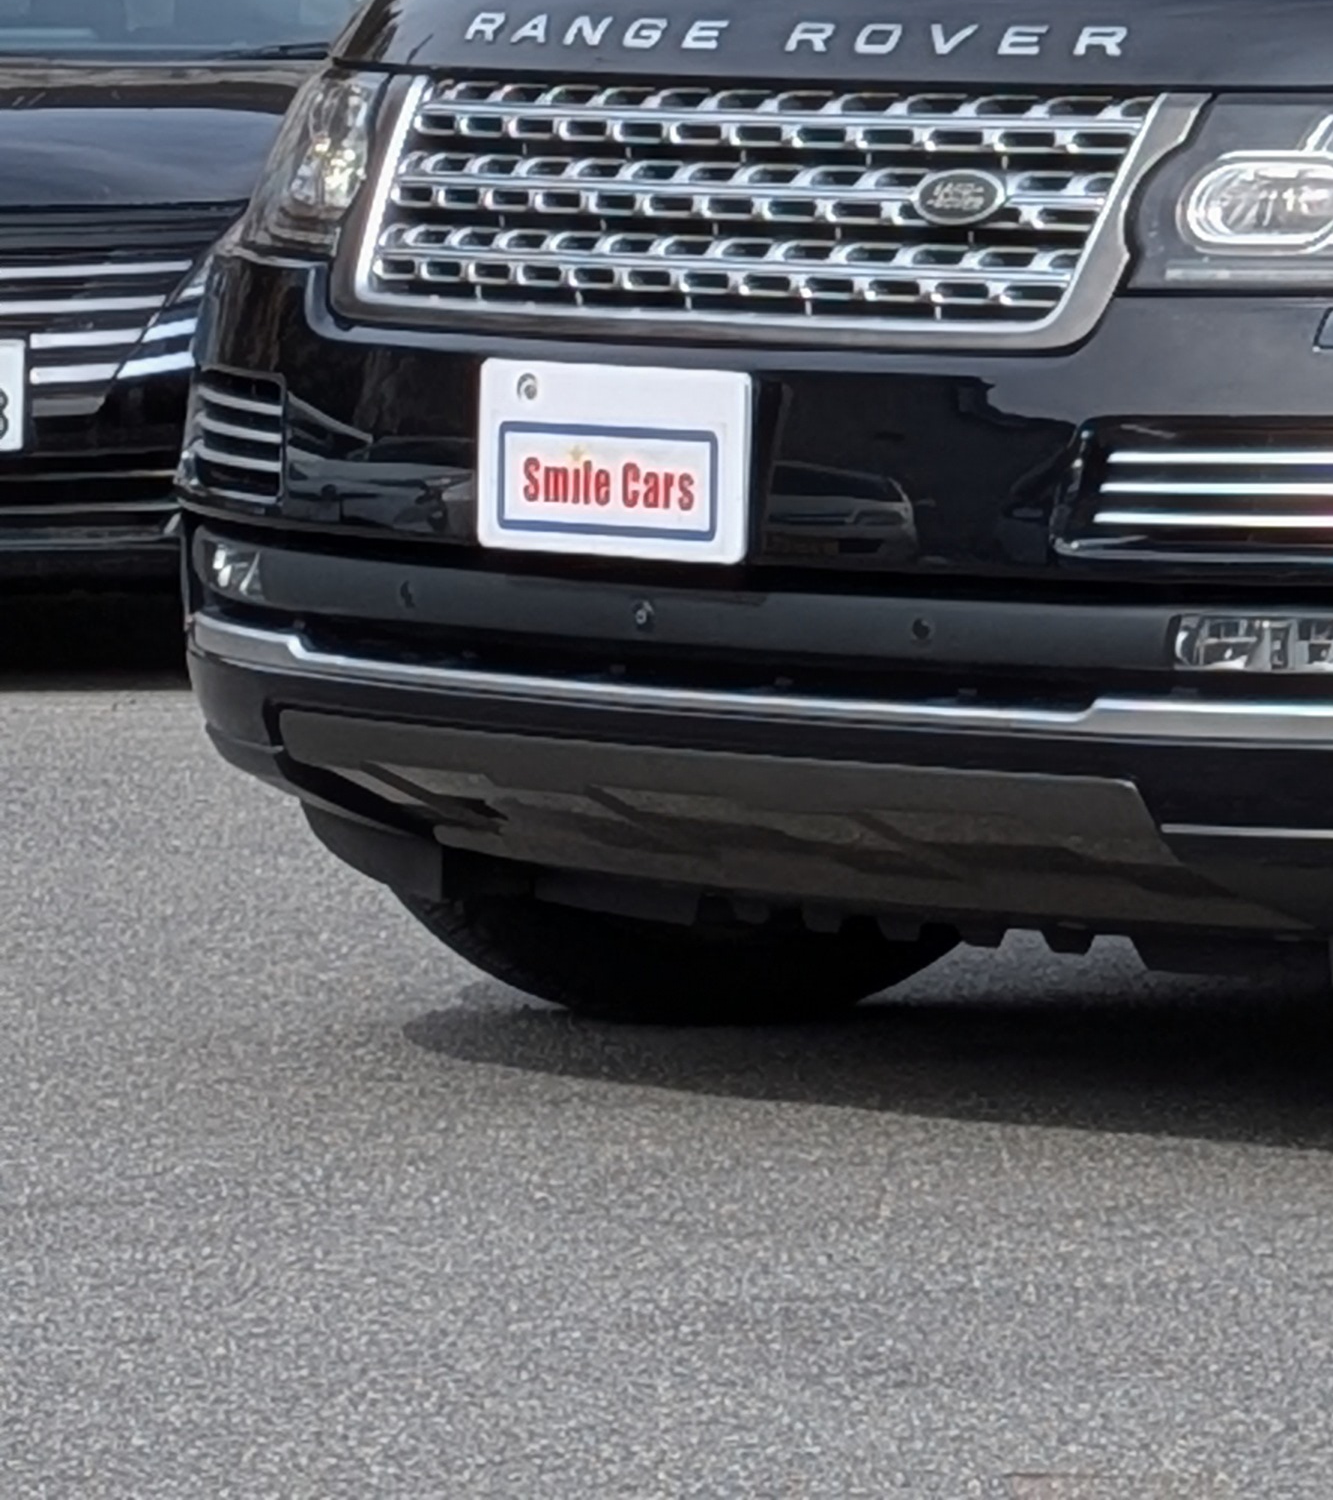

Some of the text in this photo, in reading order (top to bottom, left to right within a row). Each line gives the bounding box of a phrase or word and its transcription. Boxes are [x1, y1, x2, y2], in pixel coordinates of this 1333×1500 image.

[464, 11, 1129, 57] RANGE ROVER
[522, 455, 695, 512] Smile Cars
